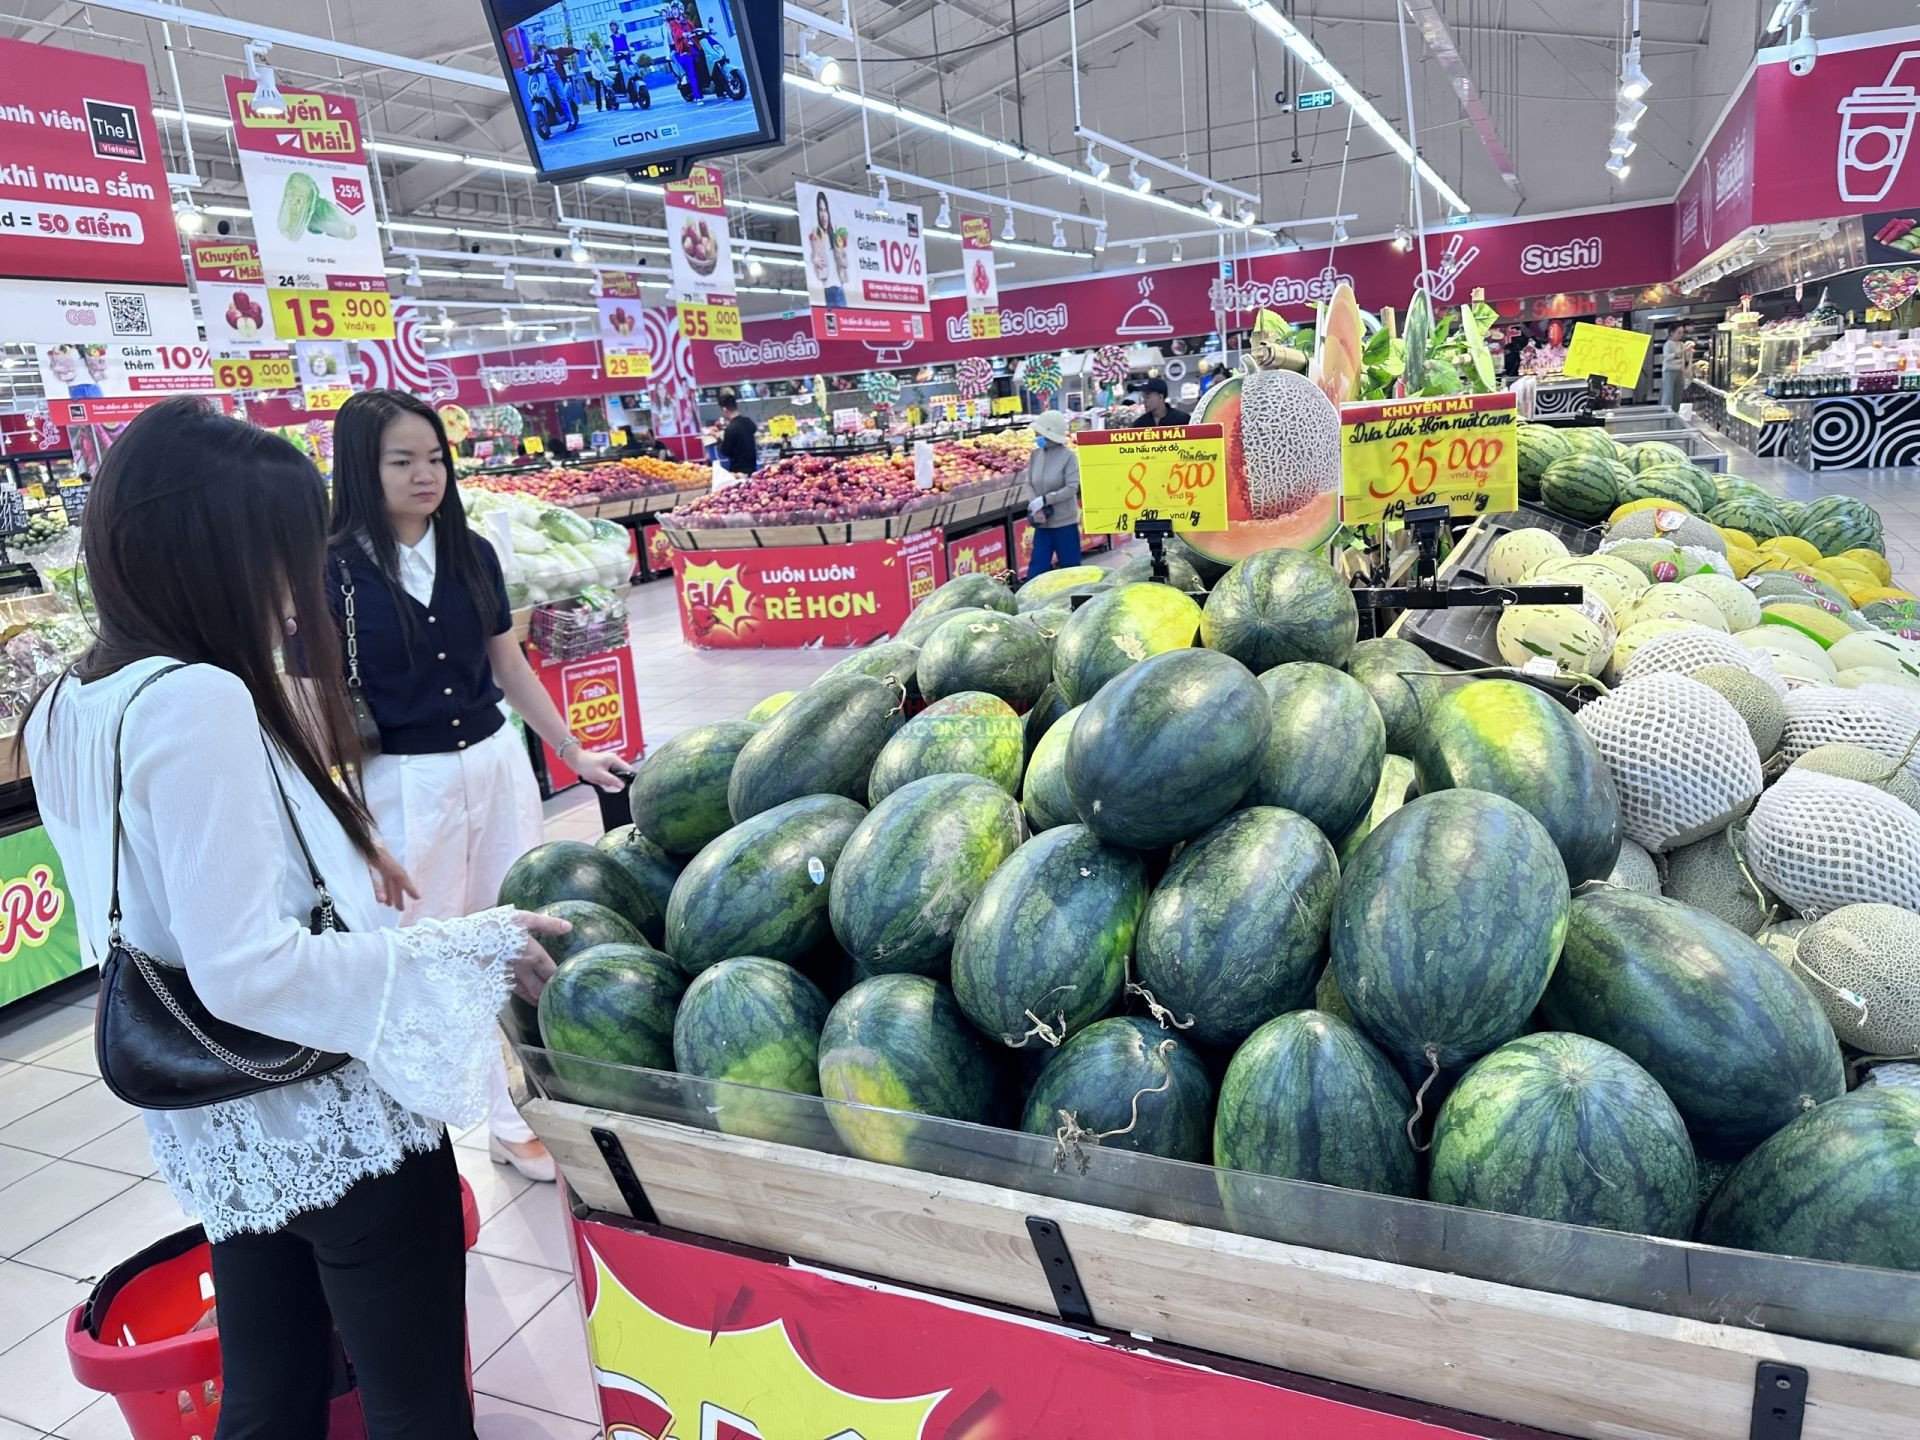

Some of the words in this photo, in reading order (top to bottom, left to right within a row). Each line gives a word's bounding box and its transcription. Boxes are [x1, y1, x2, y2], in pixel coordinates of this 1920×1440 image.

[39, 109, 87, 132] viên
[242, 99, 322, 124] Kyến
[102, 143, 136, 156] Vietnam
[613, 129, 659, 147] ICON
[0, 163, 38, 188] khi
[43, 172, 100, 195] mua
[105, 171, 155, 200] sắm
[336, 184, 361, 200] -25%
[0, 211, 15, 228] d
[37, 212, 70, 234] 50
[75, 212, 132, 238] điểm
[199, 248, 248, 264] Khuyến
[880, 239, 922, 277] 10%
[1524, 241, 1598, 270] Sushi
[278, 276, 296, 287] 24
[1274, 279, 1304, 303] ăn
[286, 298, 335, 338] 15
[341, 298, 387, 318] .900
[683, 310, 709, 337] 55
[1027, 306, 1066, 331] loại
[122, 346, 152, 357] Giảm
[156, 345, 212, 370] 10%
[717, 343, 760, 366] Thức
[762, 342, 784, 360] ăn
[786, 334, 817, 358] sẵn
[124, 359, 155, 371] thêm
[219, 365, 254, 388] 69
[610, 358, 629, 375] 29
[311, 394, 331, 408] 26
[1382, 399, 1443, 418] KHUYẾN
[1446, 396, 1474, 411] MÃI
[1110, 428, 1161, 443] KHUYẾN
[1163, 427, 1186, 440] MÃI
[1136, 444, 1150, 453] hấu
[1151, 444, 1167, 454] ruột
[1168, 442, 1180, 452] đỏ
[1368, 438, 1446, 499] 35
[1124, 462, 1146, 510] 8
[1382, 500, 1406, 520] 49
[761, 566, 807, 585] LUÔN
[808, 565, 857, 582] LUÔN
[686, 576, 735, 614] GIÁ
[765, 587, 804, 621] RẺ
[807, 591, 878, 619] HƠN
[572, 700, 619, 724] 2.000
[0, 871, 59, 955] Rẻ
